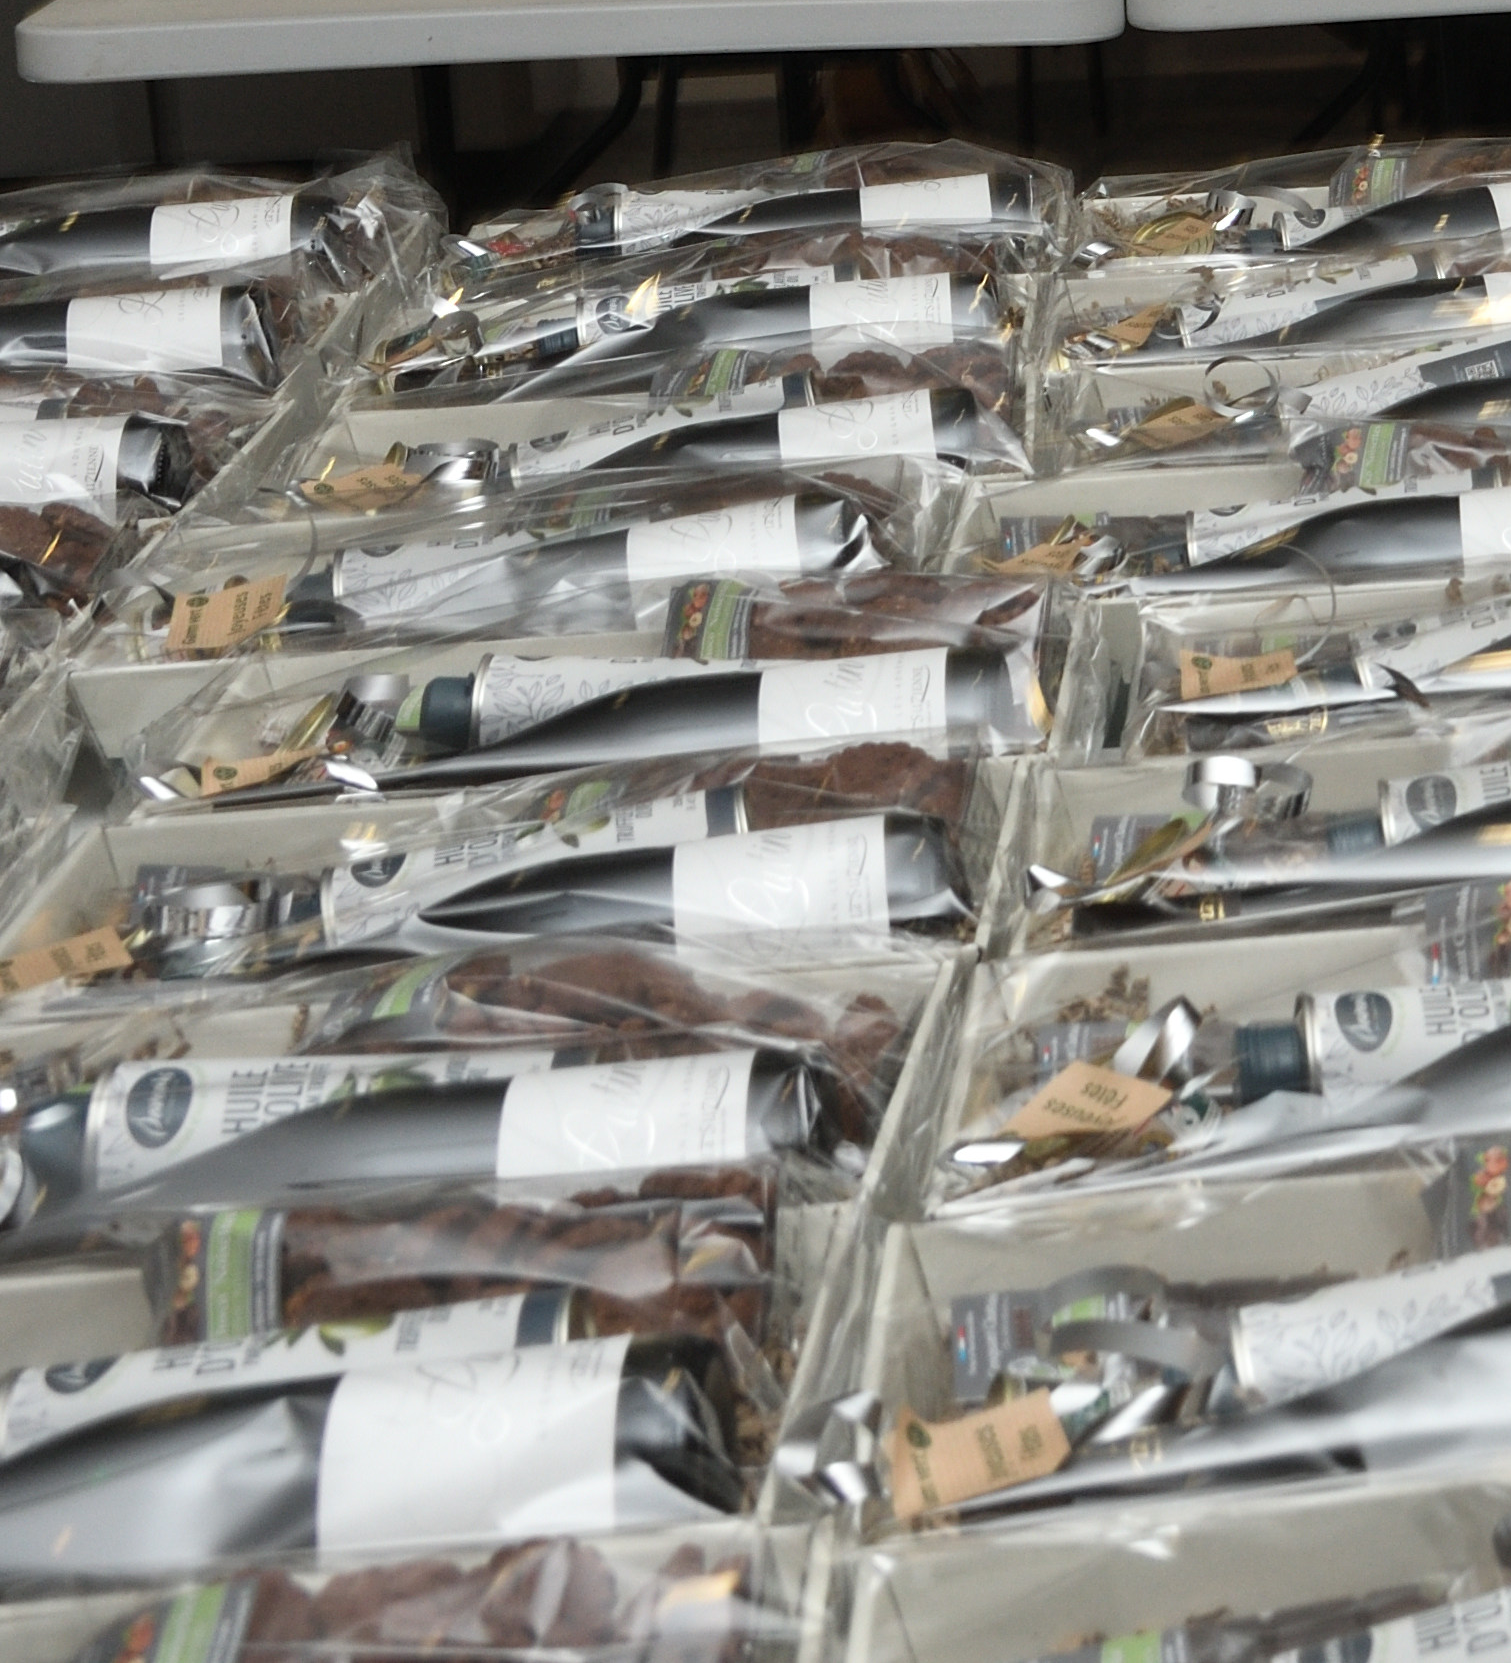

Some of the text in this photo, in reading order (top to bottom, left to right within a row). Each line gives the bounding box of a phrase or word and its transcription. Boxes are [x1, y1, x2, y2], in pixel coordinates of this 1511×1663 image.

[227, 590, 248, 637] Joyeuses
[252, 592, 272, 622] Fêtes
[222, 1065, 261, 1136] HUILE
